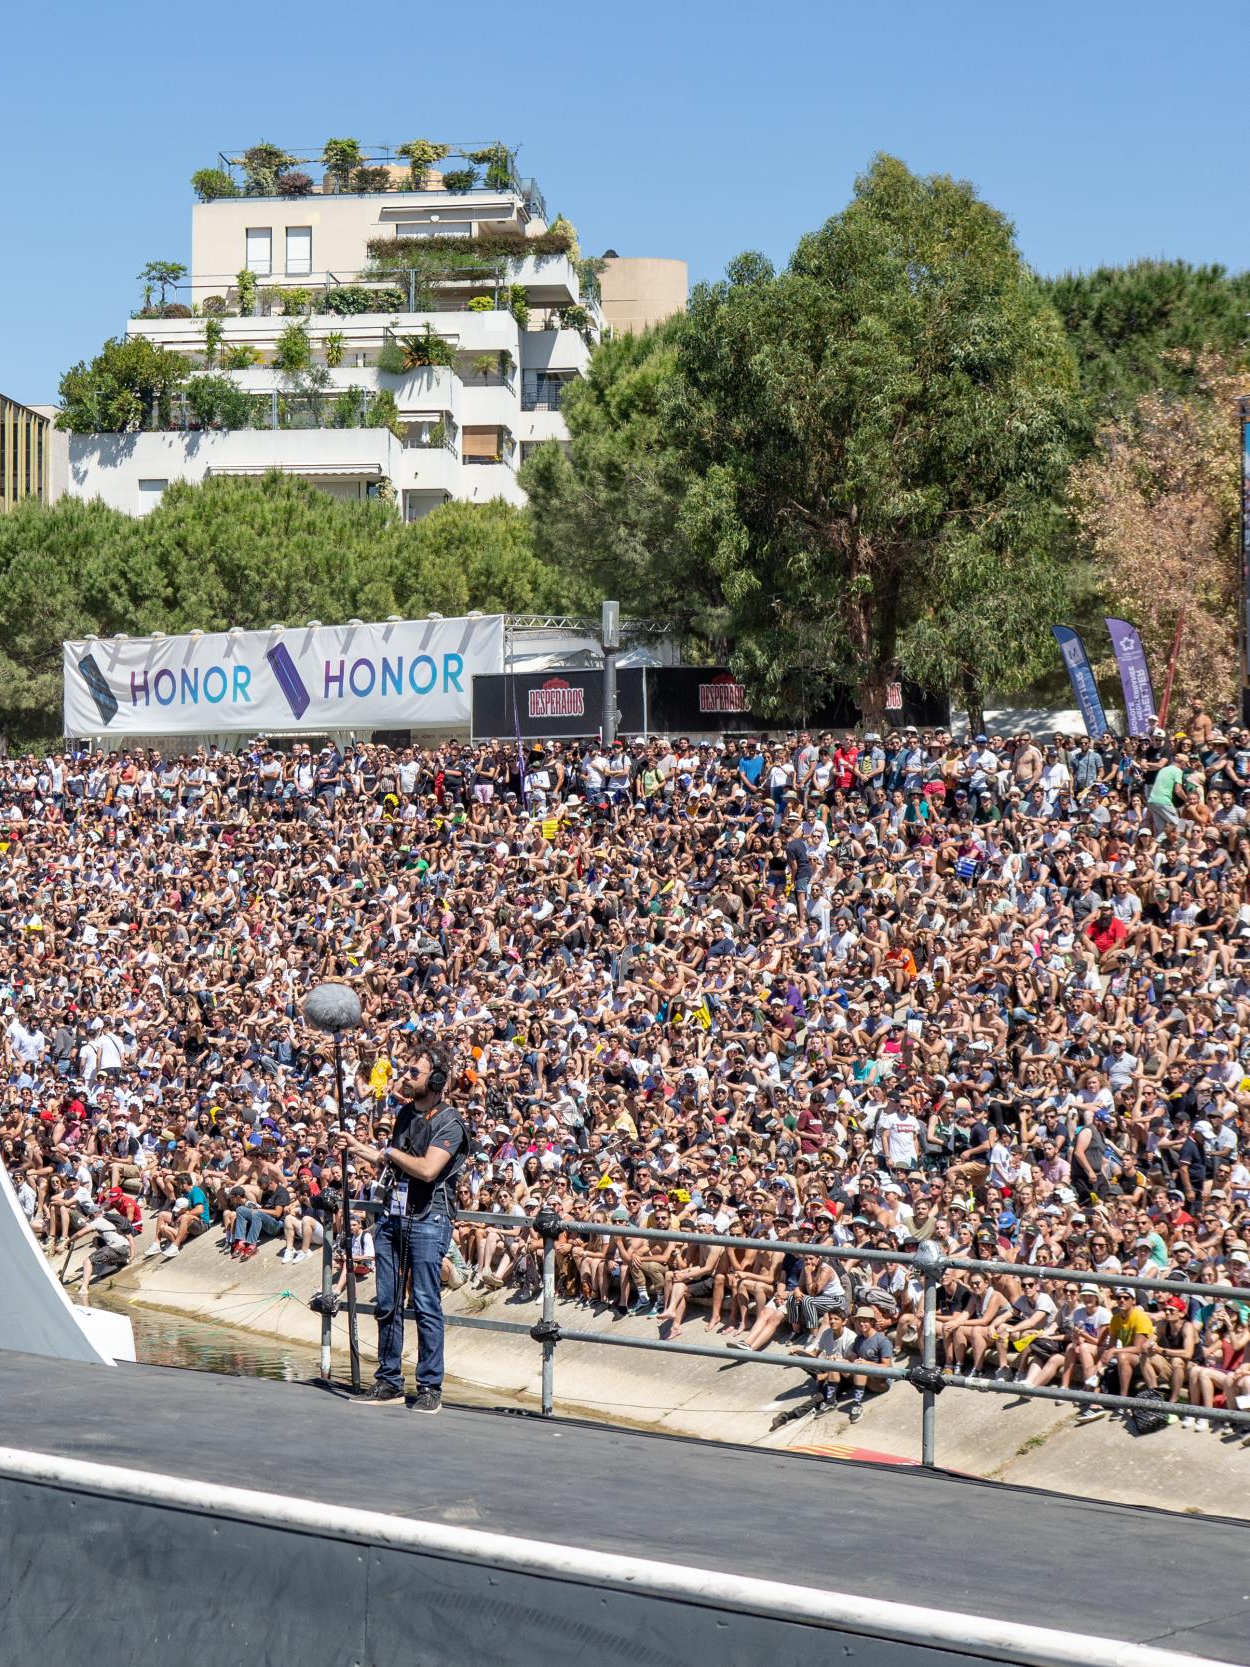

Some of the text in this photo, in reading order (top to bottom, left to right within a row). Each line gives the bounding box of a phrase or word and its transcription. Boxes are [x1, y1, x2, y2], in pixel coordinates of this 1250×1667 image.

[130, 665, 252, 707] HONOR
[324, 653, 464, 699] HONOR
[529, 688, 585, 717] DESPERADOS
